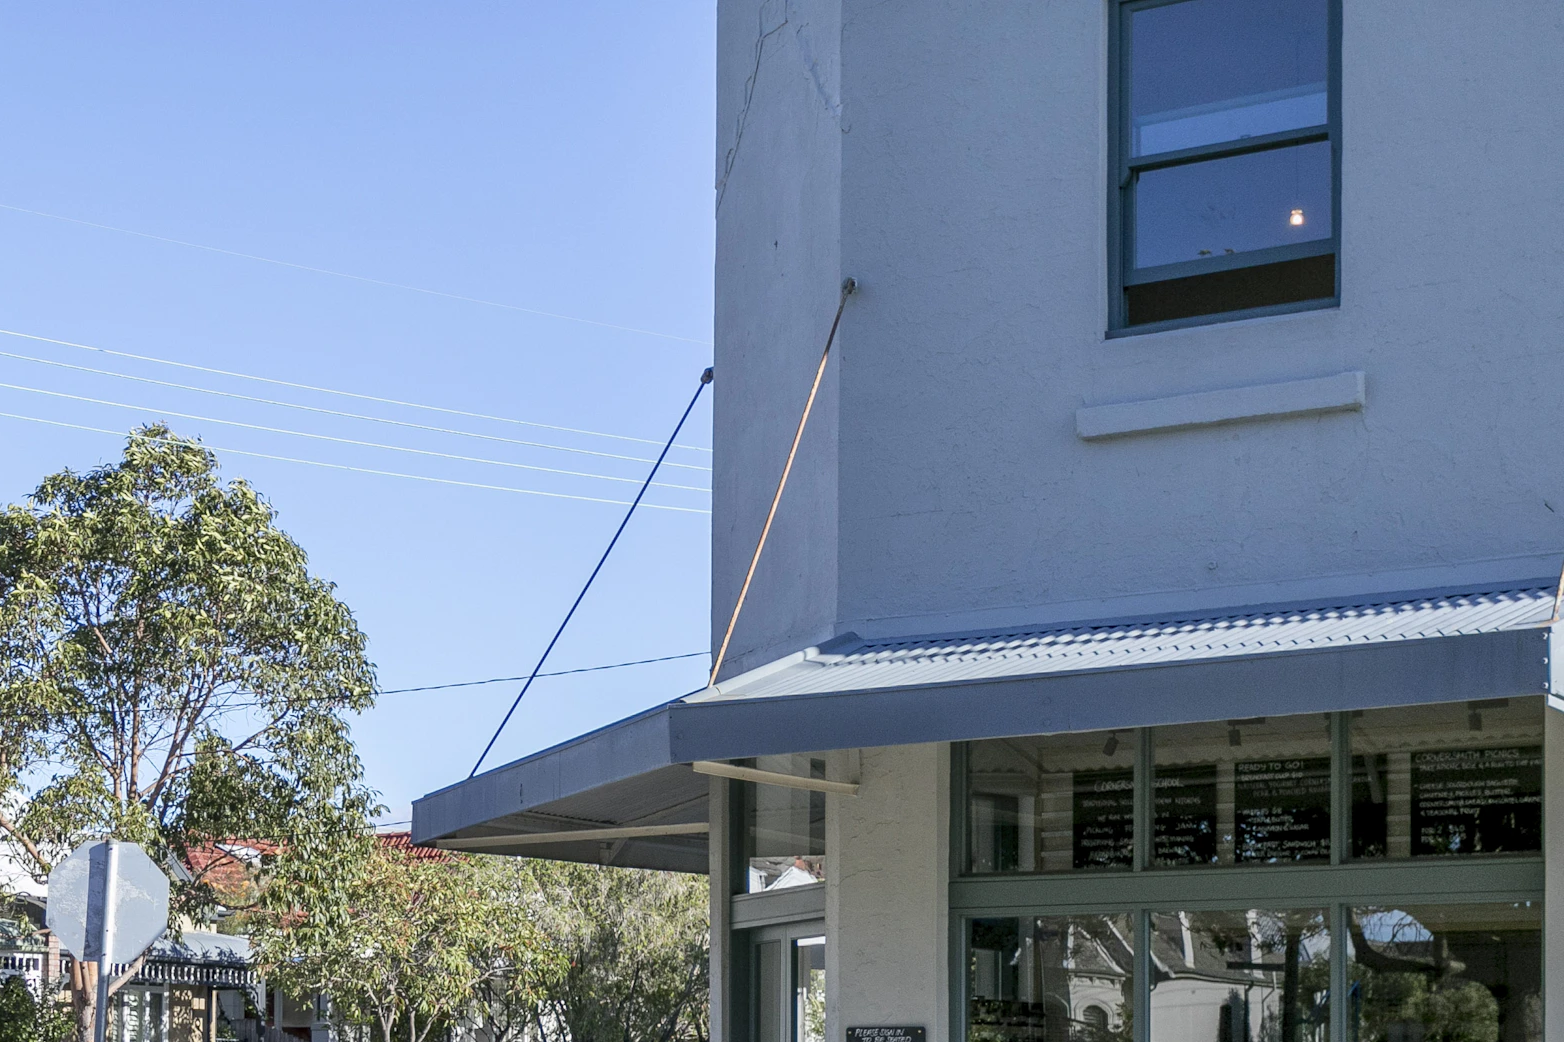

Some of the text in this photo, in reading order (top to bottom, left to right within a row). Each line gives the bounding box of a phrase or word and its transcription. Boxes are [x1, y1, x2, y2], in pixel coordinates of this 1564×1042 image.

[1415, 749, 1519, 762] CORNERSMITH PICNICS
[1238, 761, 1304, 772] READY TO GO!
[1094, 780, 1134, 793] CORNERS
[854, 1028, 906, 1037] PLEASE SIGN IN
